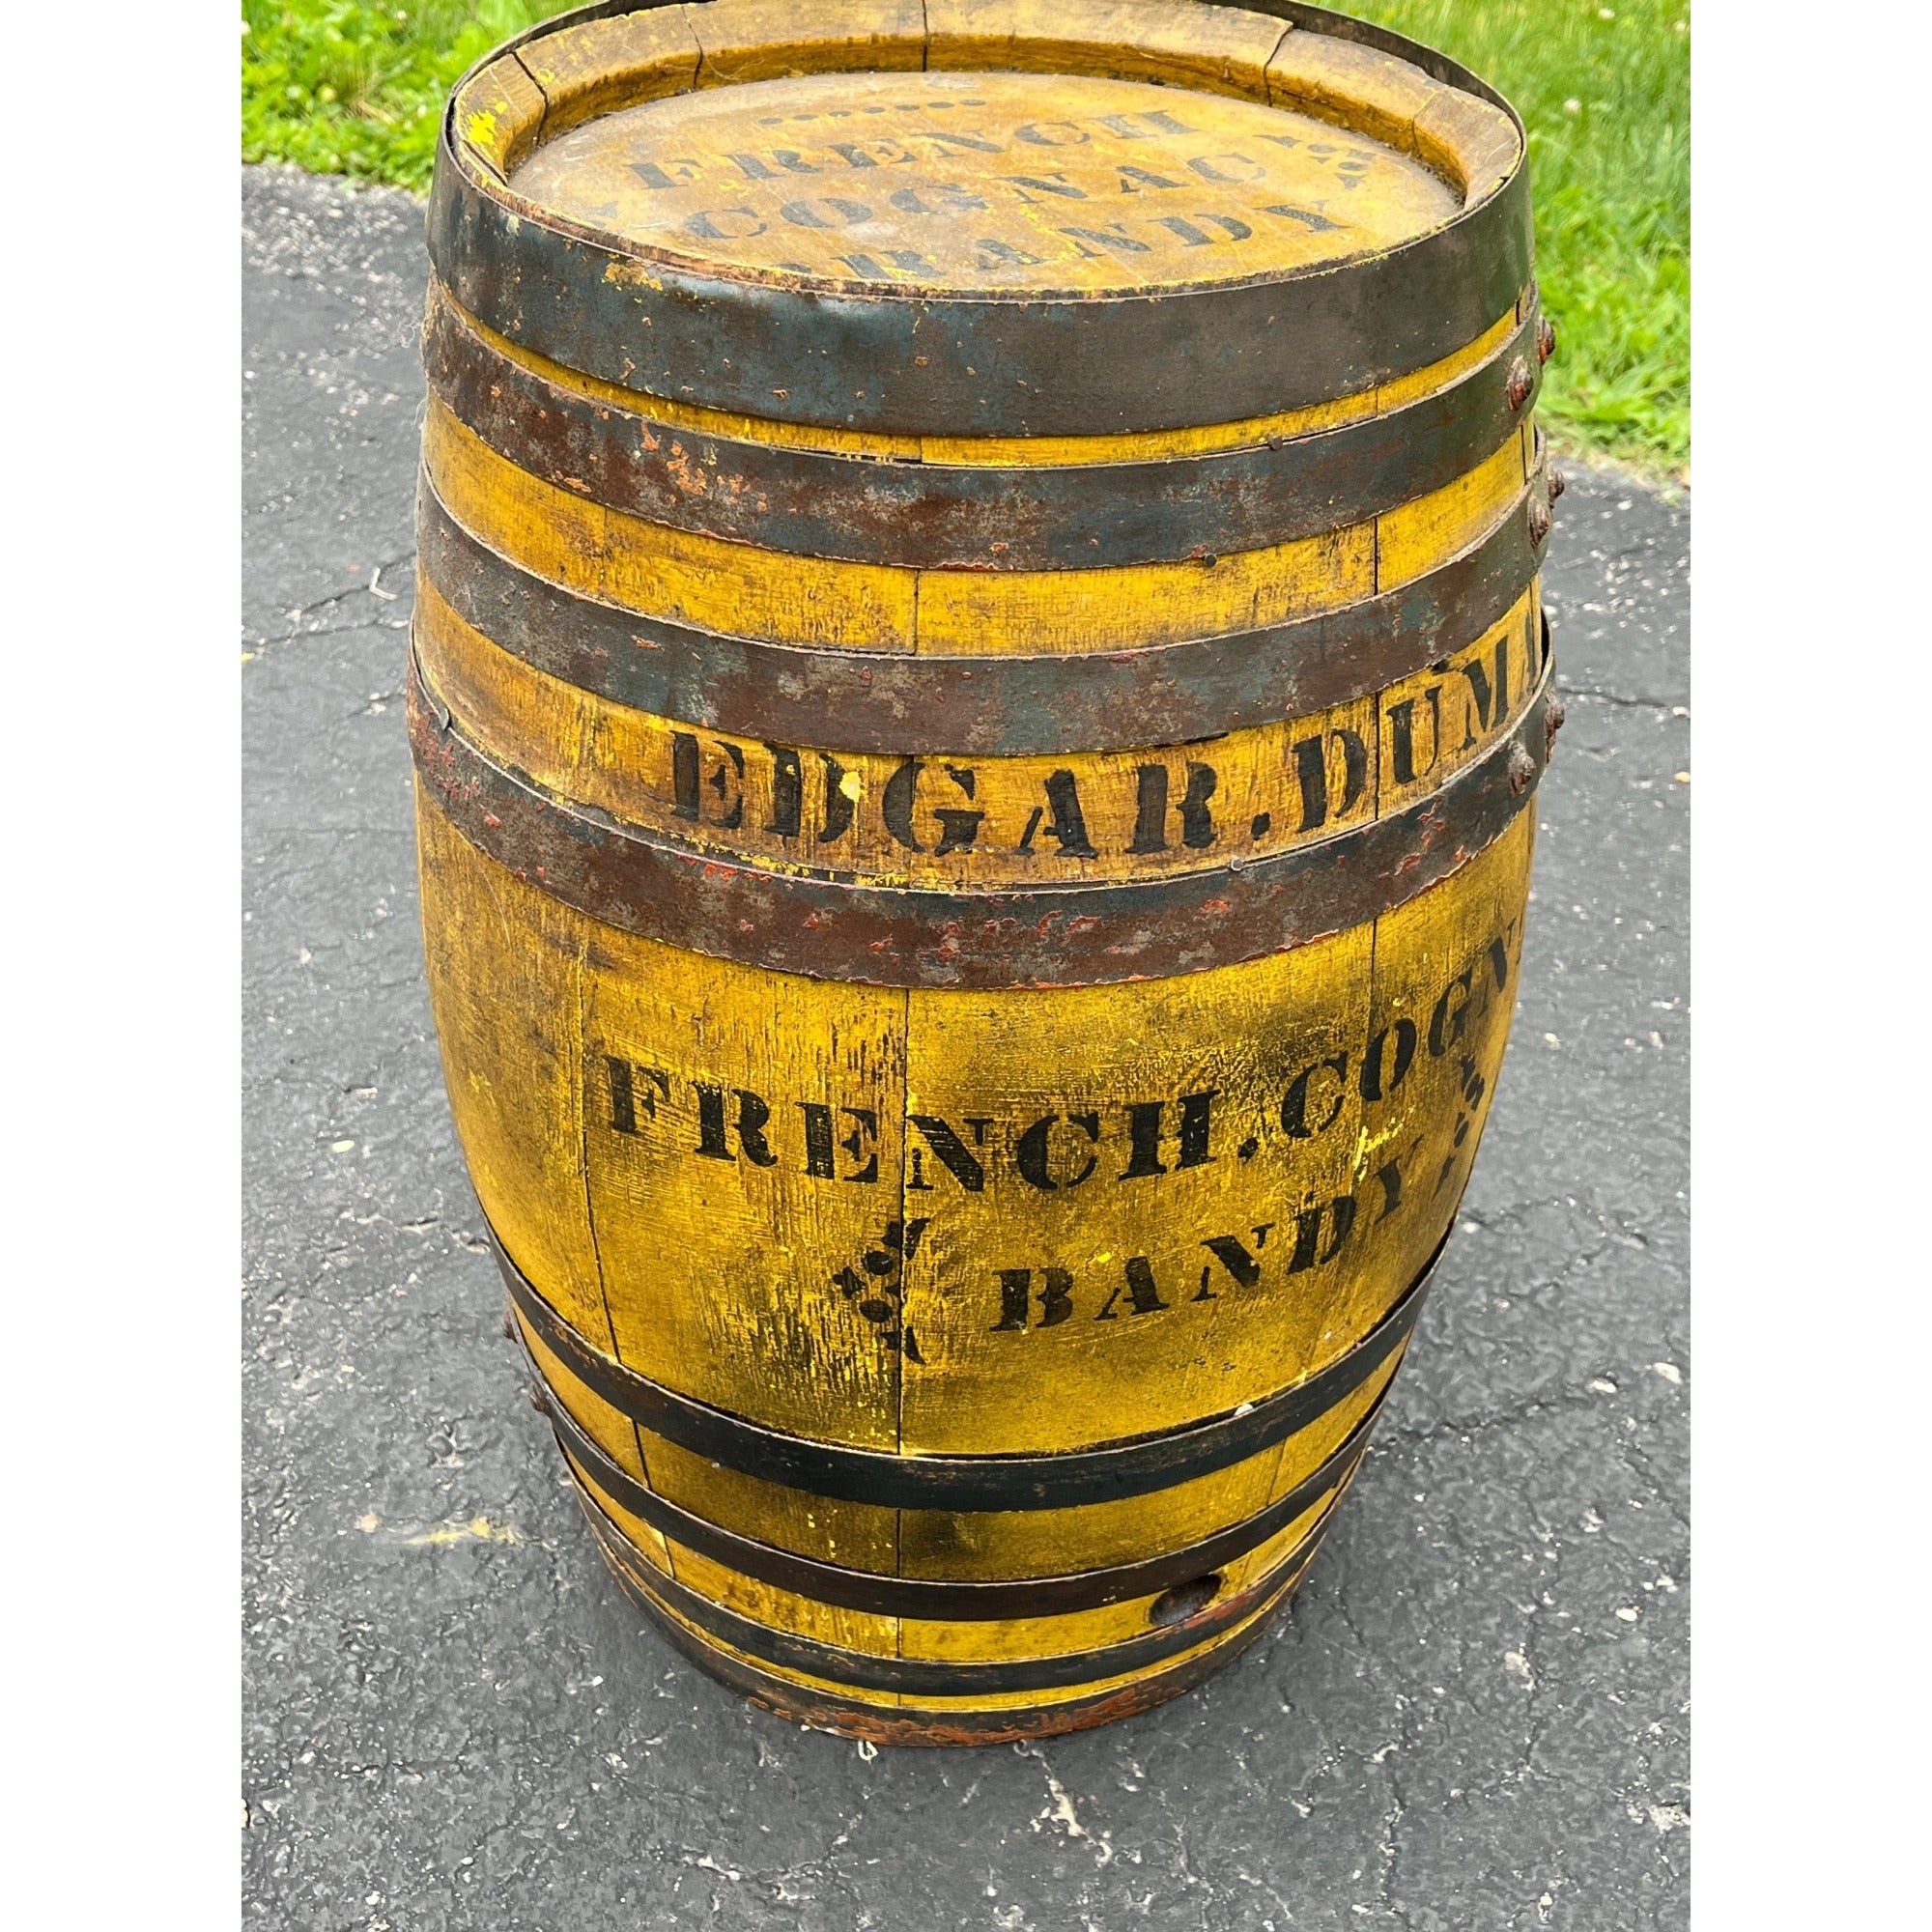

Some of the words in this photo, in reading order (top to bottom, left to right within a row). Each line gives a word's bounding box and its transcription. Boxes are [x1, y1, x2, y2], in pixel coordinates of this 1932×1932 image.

[625, 109, 1199, 189] FRENCH
[684, 151, 1266, 240] COGNAC
[777, 198, 1351, 279] RANDY
[989, 1134, 1423, 1332] BANDY
